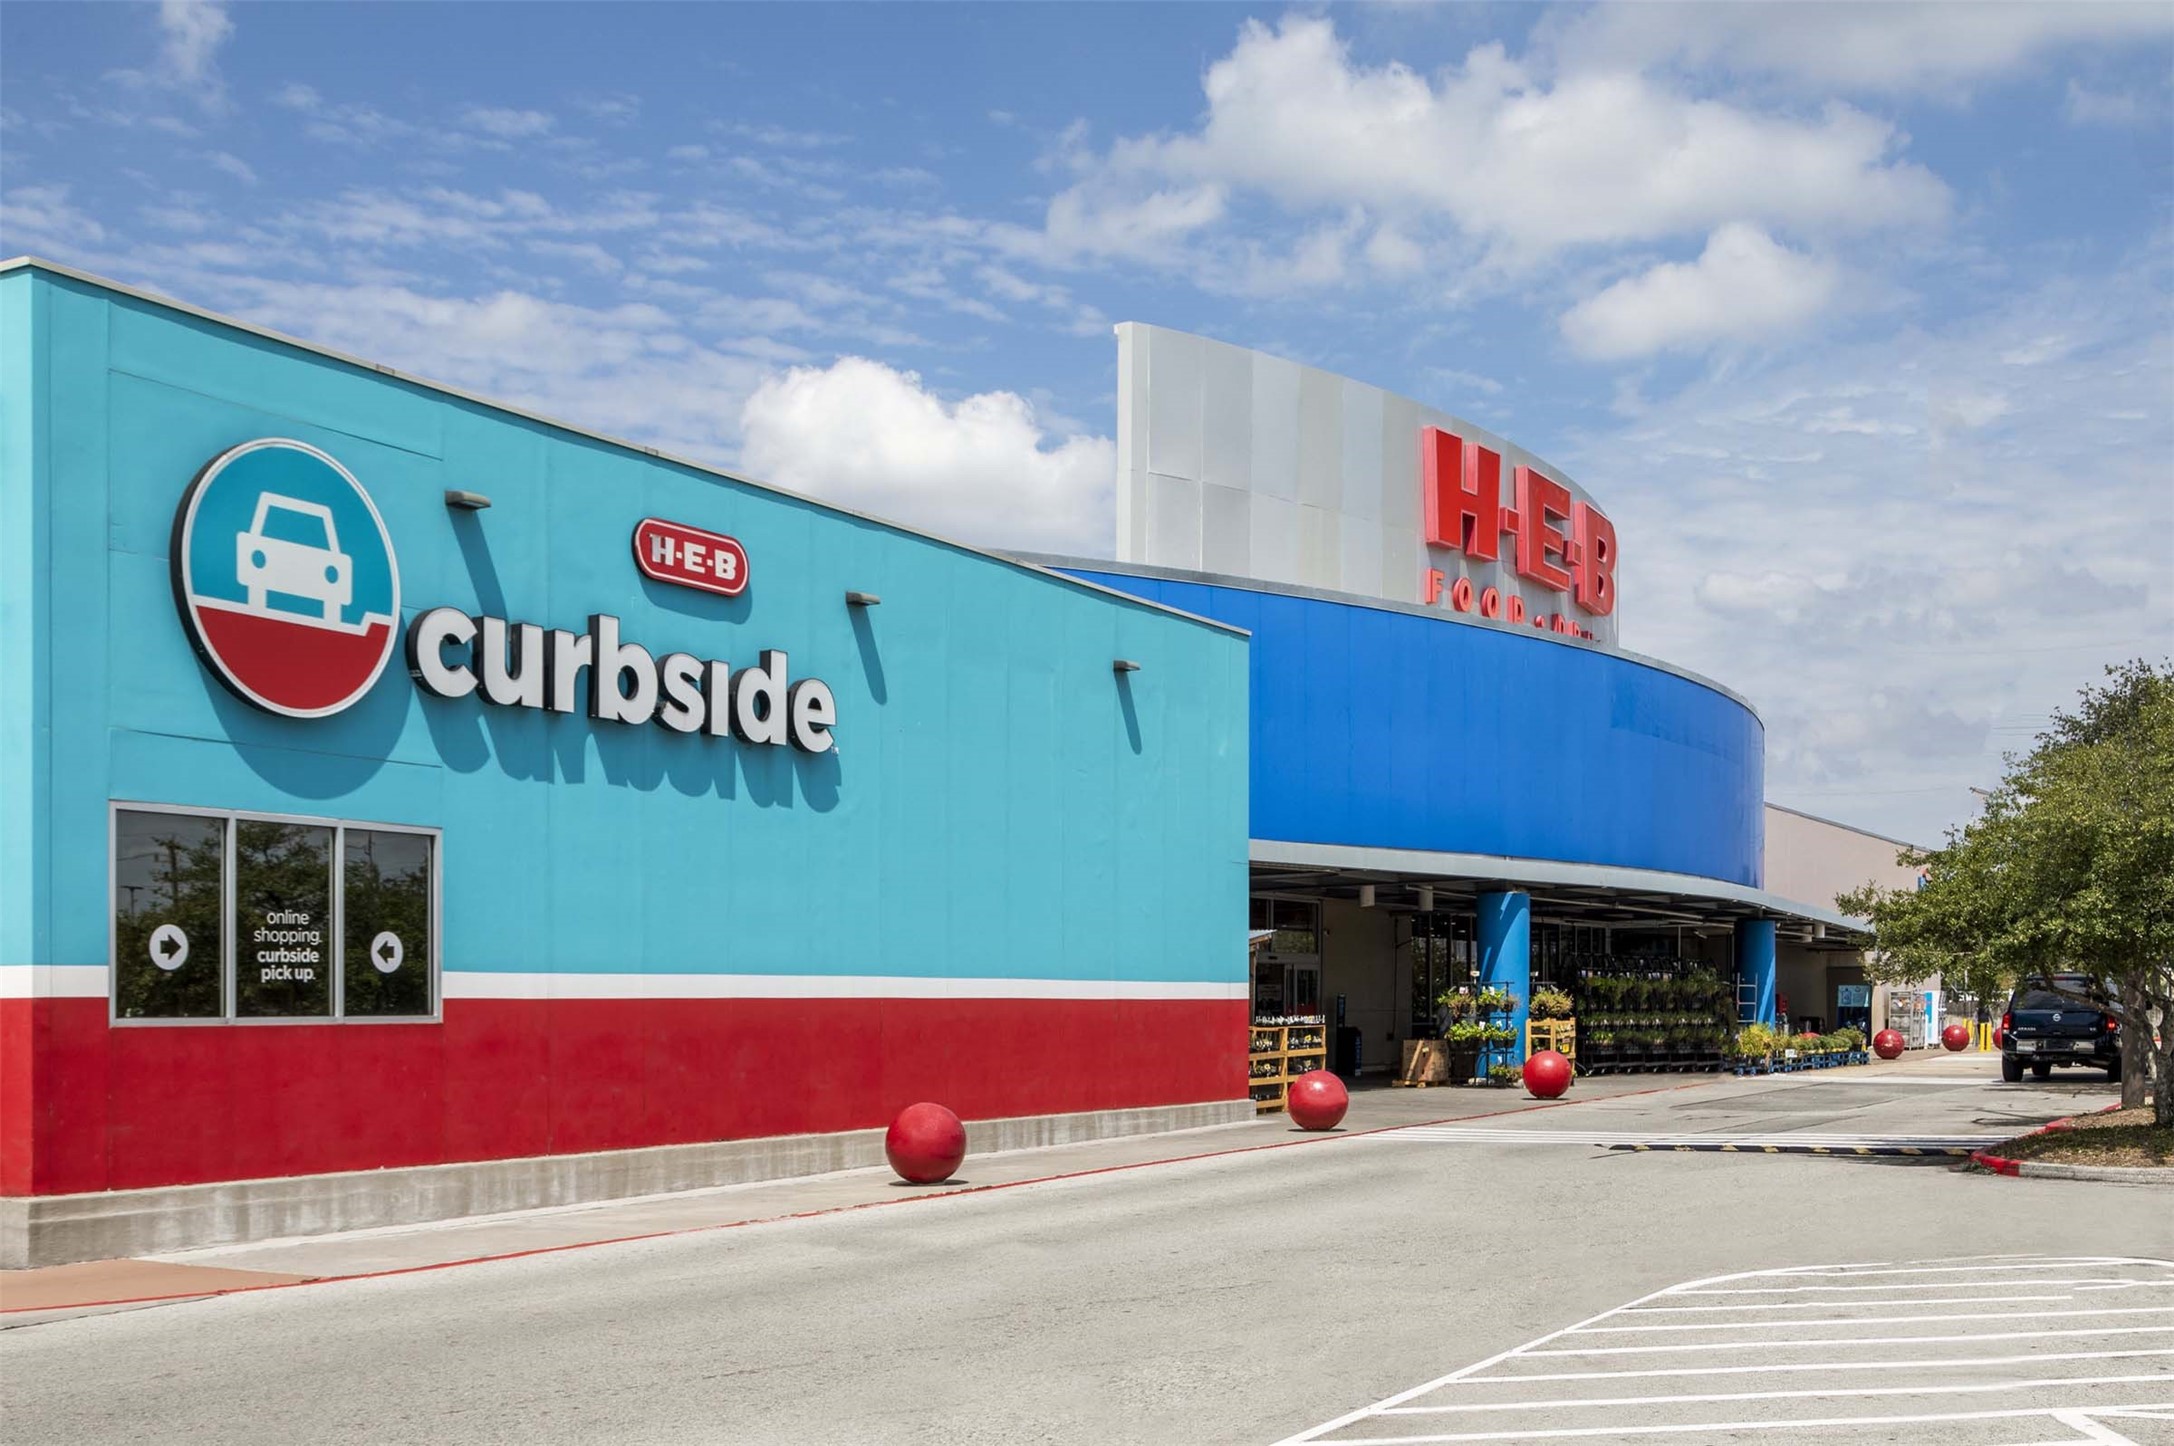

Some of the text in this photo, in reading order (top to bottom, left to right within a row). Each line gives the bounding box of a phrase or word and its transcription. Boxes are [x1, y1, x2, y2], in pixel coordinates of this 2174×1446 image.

[1425, 567, 1525, 625] FOOD
[405, 606, 836, 753] curbside
[266, 909, 310, 925] online
[257, 947, 320, 963] curbside
[261, 964, 293, 983] pick
